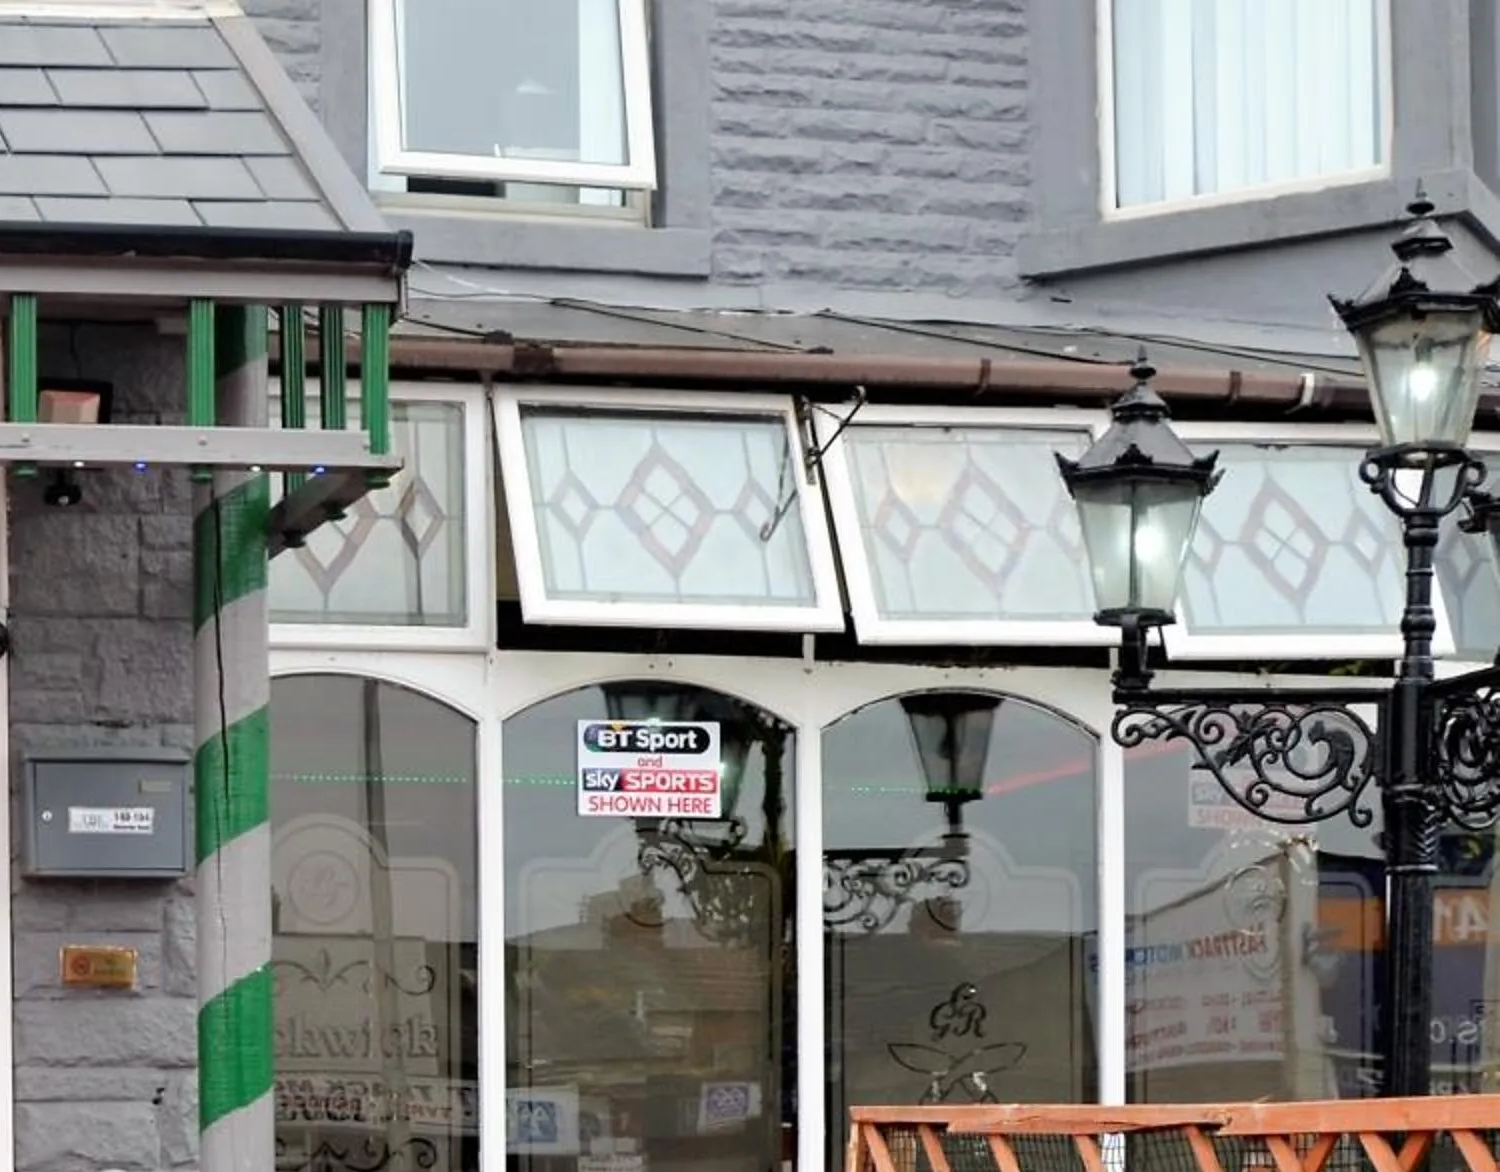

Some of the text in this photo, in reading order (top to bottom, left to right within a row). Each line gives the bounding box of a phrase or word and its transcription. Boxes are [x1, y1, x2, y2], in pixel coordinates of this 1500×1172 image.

[597, 729, 697, 752] BT Sport
[637, 756, 664, 767] and
[585, 769, 715, 792] sky SPORTS
[588, 796, 713, 814] SHOWN HERE
